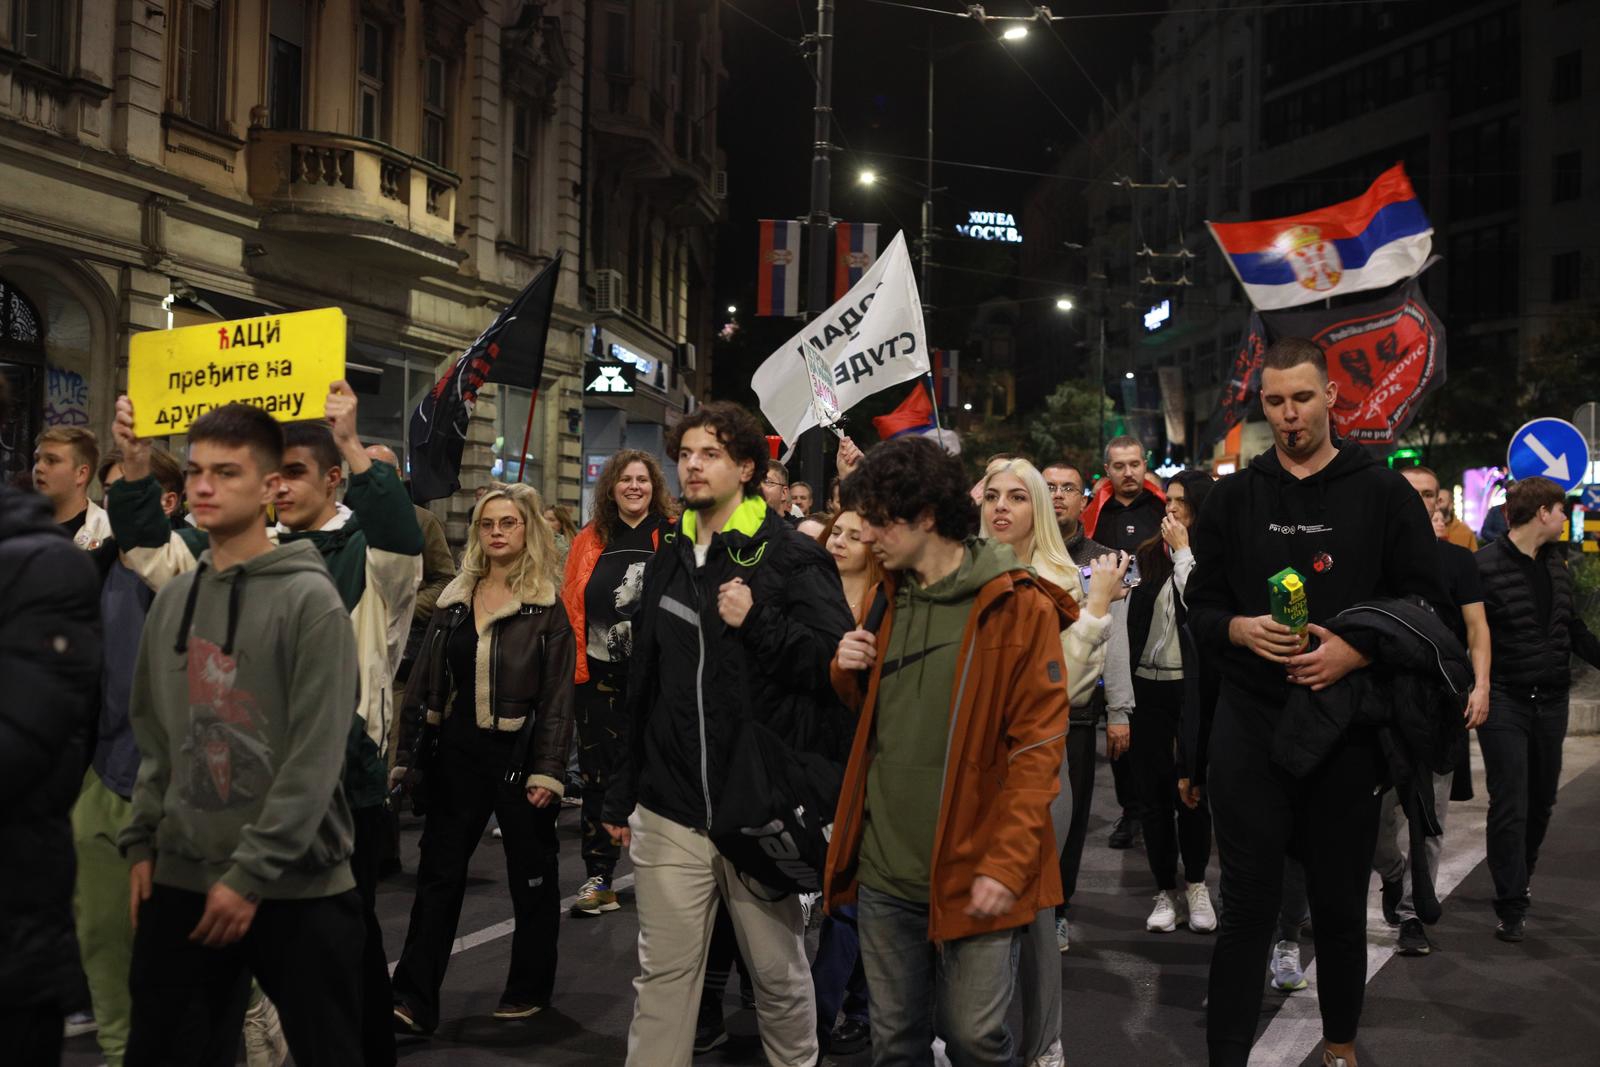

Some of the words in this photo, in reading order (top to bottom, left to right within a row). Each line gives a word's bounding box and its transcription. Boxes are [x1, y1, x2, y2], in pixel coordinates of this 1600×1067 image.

[956, 224, 1022, 242] ОСКВ
[169, 361, 259, 393] пређите
[266, 359, 292, 378] на
